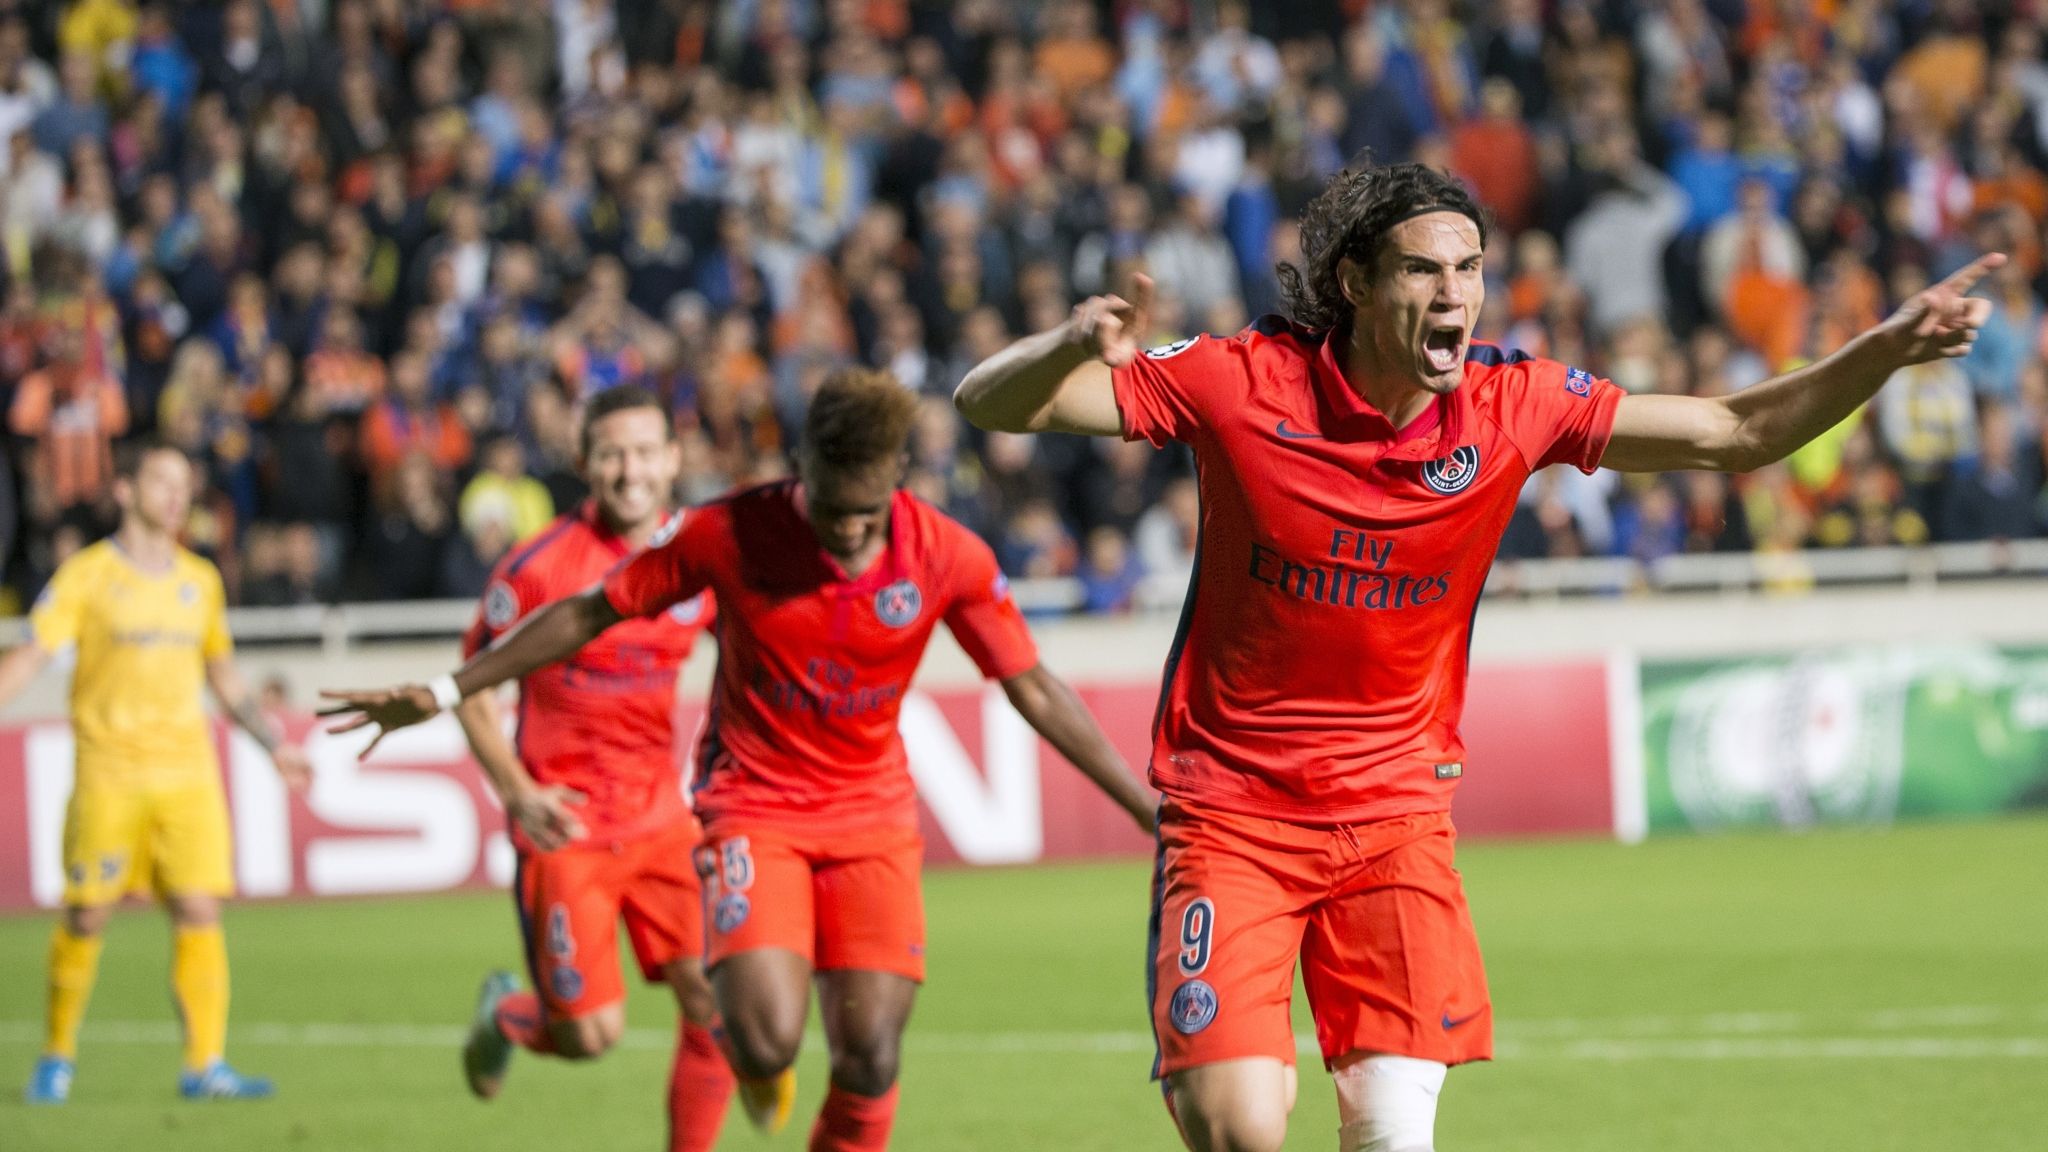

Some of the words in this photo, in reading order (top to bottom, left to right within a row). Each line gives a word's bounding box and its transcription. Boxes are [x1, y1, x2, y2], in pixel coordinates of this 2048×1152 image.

[1249, 540, 1454, 610] Emirates
[1328, 528, 1395, 570] Fly
[1178, 896, 1215, 978] 9
